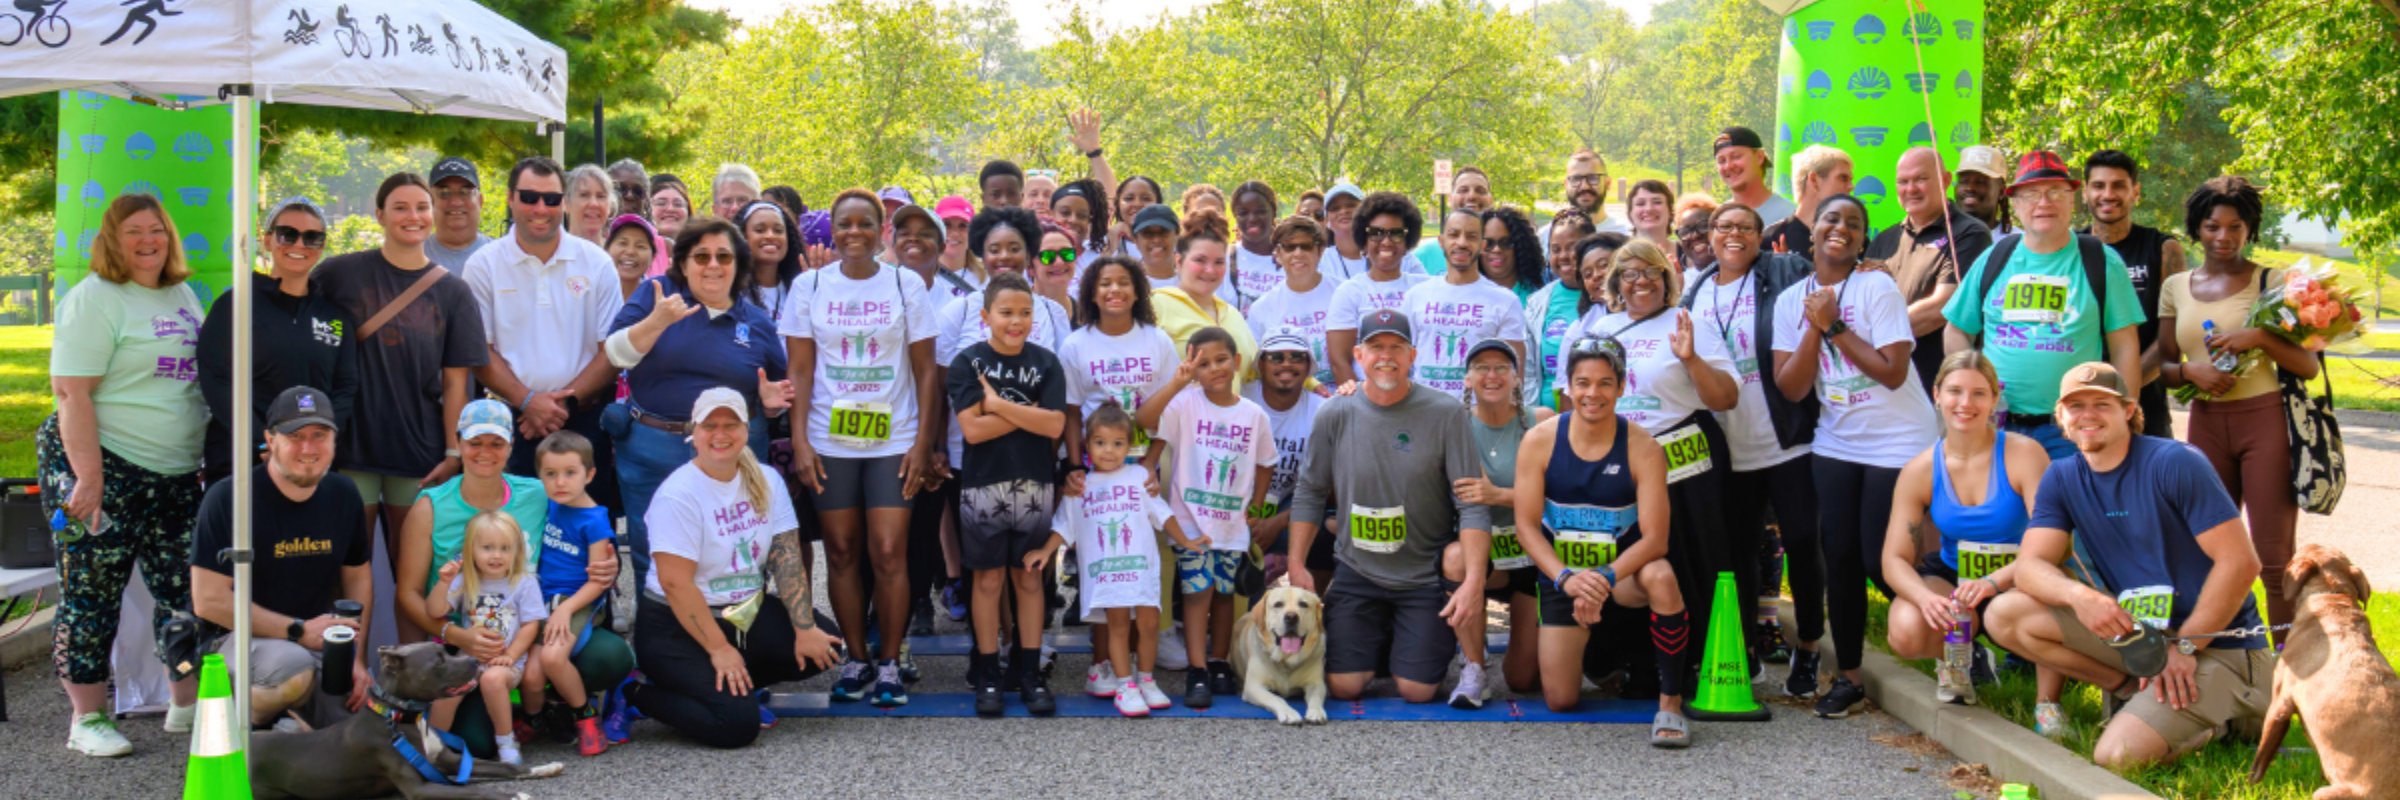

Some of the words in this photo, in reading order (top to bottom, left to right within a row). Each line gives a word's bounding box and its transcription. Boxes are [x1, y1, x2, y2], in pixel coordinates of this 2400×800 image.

[2010, 283, 2063, 310] 1915
[837, 316, 892, 327] HEALING
[1433, 316, 1483, 329] HEALING
[1995, 324, 2031, 340] 5K
[853, 383, 881, 392] 2025
[1102, 374, 1153, 386] HEALING
[836, 408, 889, 439] 1976
[1664, 432, 1709, 470] 1934
[1091, 502, 1141, 516] HEALING
[1355, 515, 1403, 541] 1956
[274, 536, 332, 558] golden
[1493, 534, 1523, 559] 195
[1560, 542, 1611, 567] 1951
[1111, 571, 1139, 583] 2025
[1718, 661, 1741, 671] MSE
